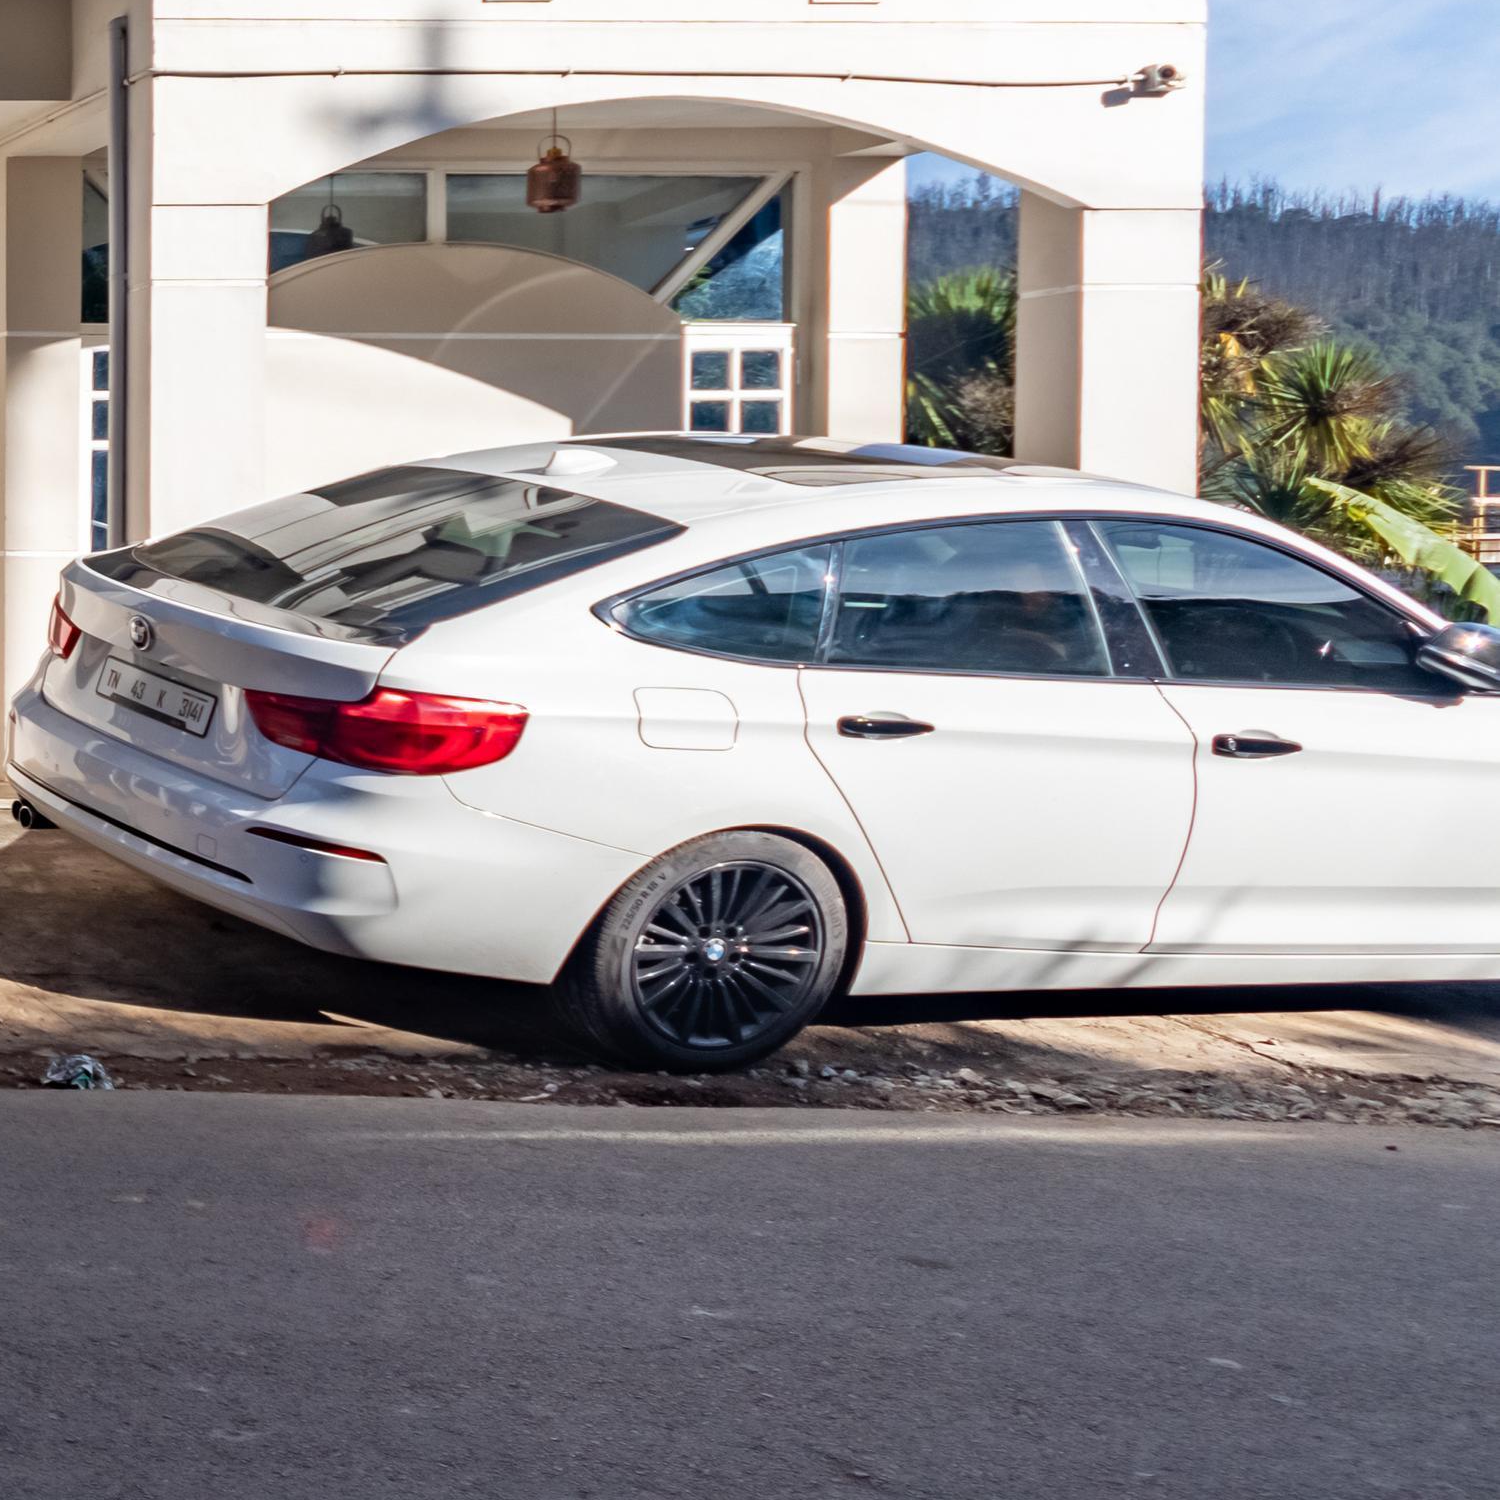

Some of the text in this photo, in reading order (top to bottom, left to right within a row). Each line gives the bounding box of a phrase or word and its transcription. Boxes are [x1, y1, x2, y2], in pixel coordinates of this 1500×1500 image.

[107, 669, 204, 722] TN 43 K 3141
